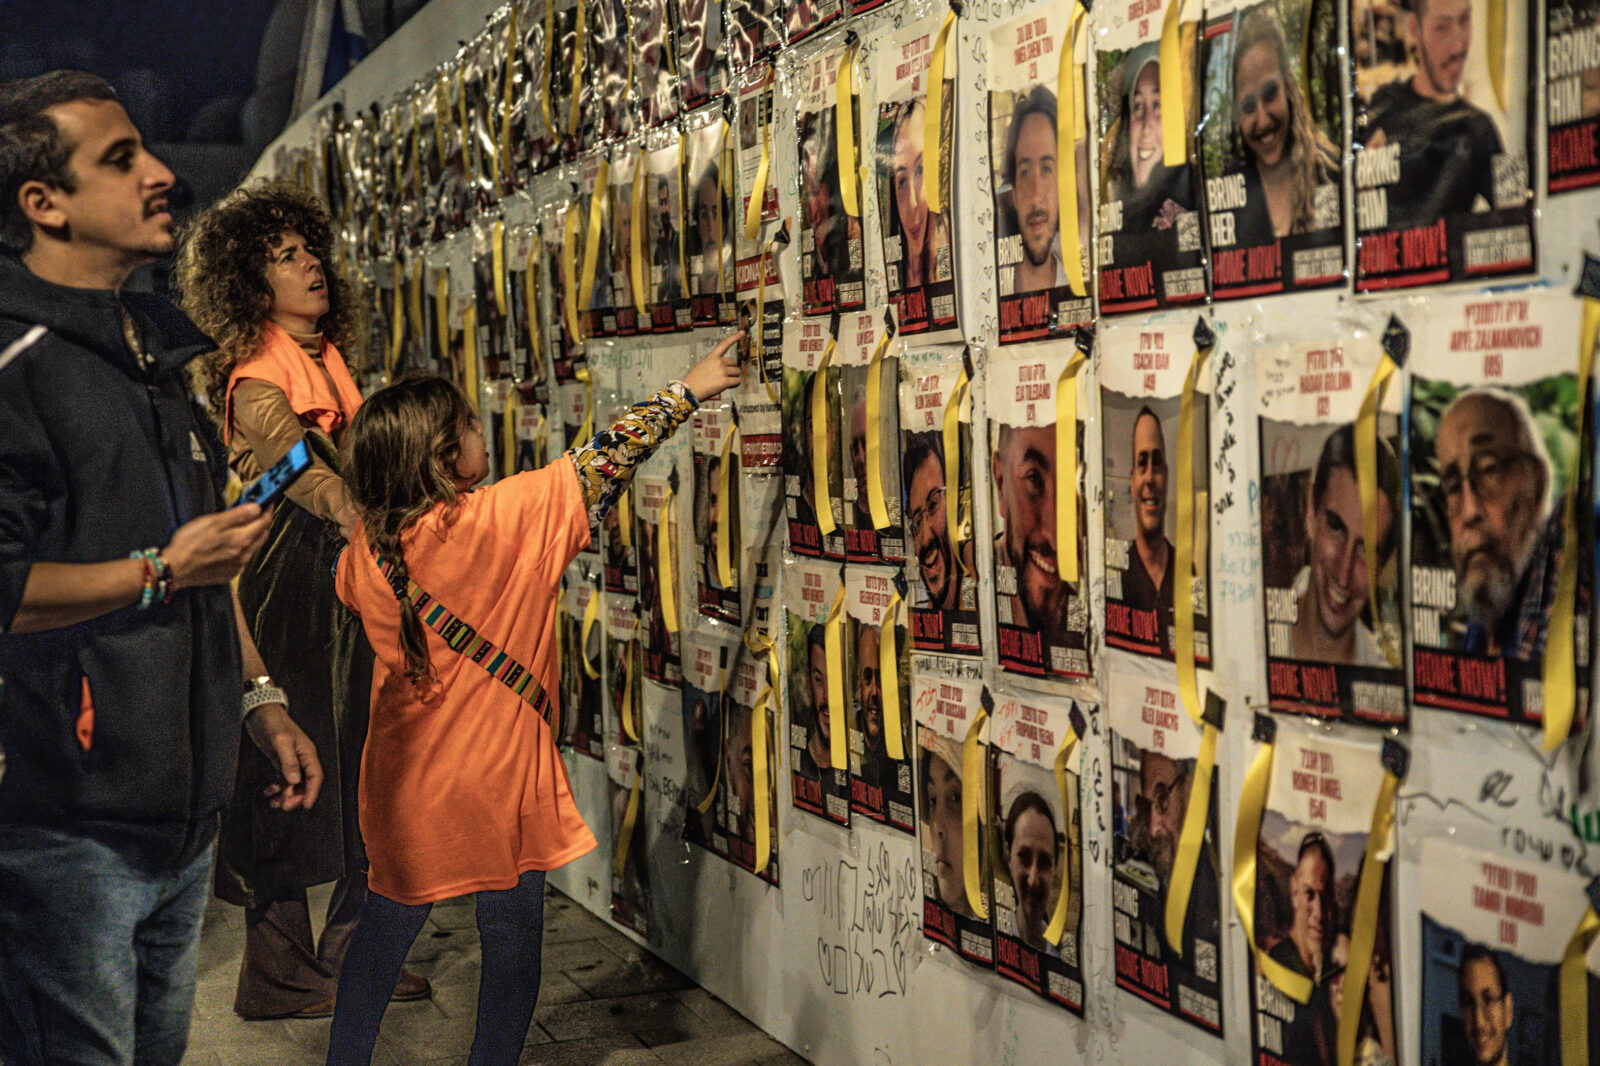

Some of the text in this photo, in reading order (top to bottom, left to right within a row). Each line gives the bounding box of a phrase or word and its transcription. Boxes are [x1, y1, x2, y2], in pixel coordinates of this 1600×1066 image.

[1549, 24, 1600, 79] BRING
[1549, 74, 1582, 127] HIM
[1355, 143, 1399, 188] BRING
[1549, 122, 1598, 174] HOME
[1207, 173, 1248, 213] BRING
[1356, 187, 1388, 231] HIM
[997, 233, 1023, 266] BRING
[1210, 211, 1237, 247] HER
[1358, 230, 1400, 274] HOME
[1401, 217, 1448, 268] NOW!
[1123, 260, 1155, 298] NOW!
[1247, 237, 1282, 280] NOW!
[1266, 587, 1299, 624] BRING
[1411, 566, 1456, 611] BRING
[1412, 606, 1441, 648] HIM
[1457, 656, 1507, 704] NOW!
